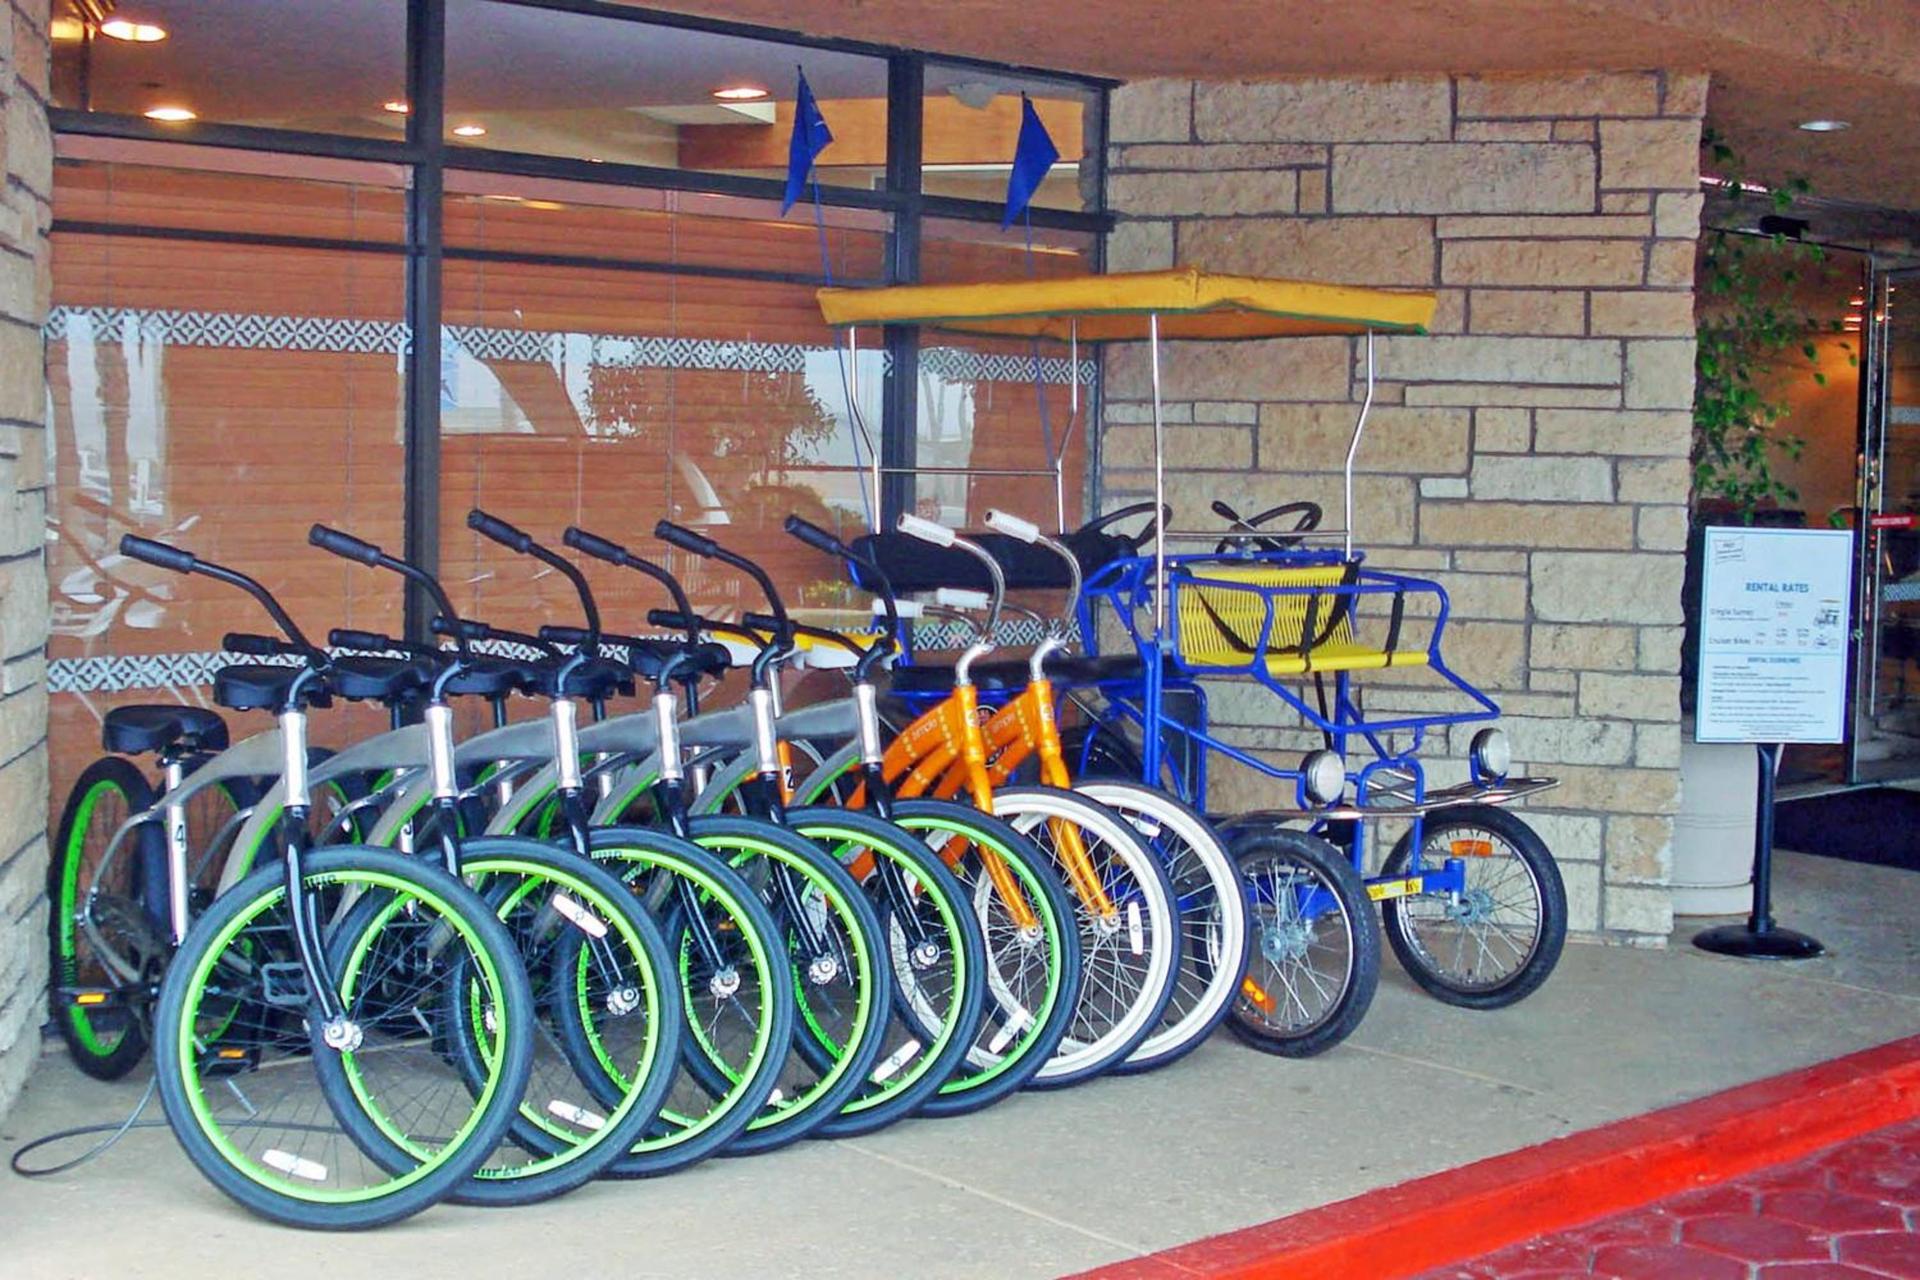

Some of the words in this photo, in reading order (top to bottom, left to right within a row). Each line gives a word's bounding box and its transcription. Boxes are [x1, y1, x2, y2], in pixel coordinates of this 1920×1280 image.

[1746, 582, 1779, 593] RENTAL
[1782, 583, 1809, 593] RATES
[785, 768, 795, 790] 2
[175, 824, 185, 848] 4
